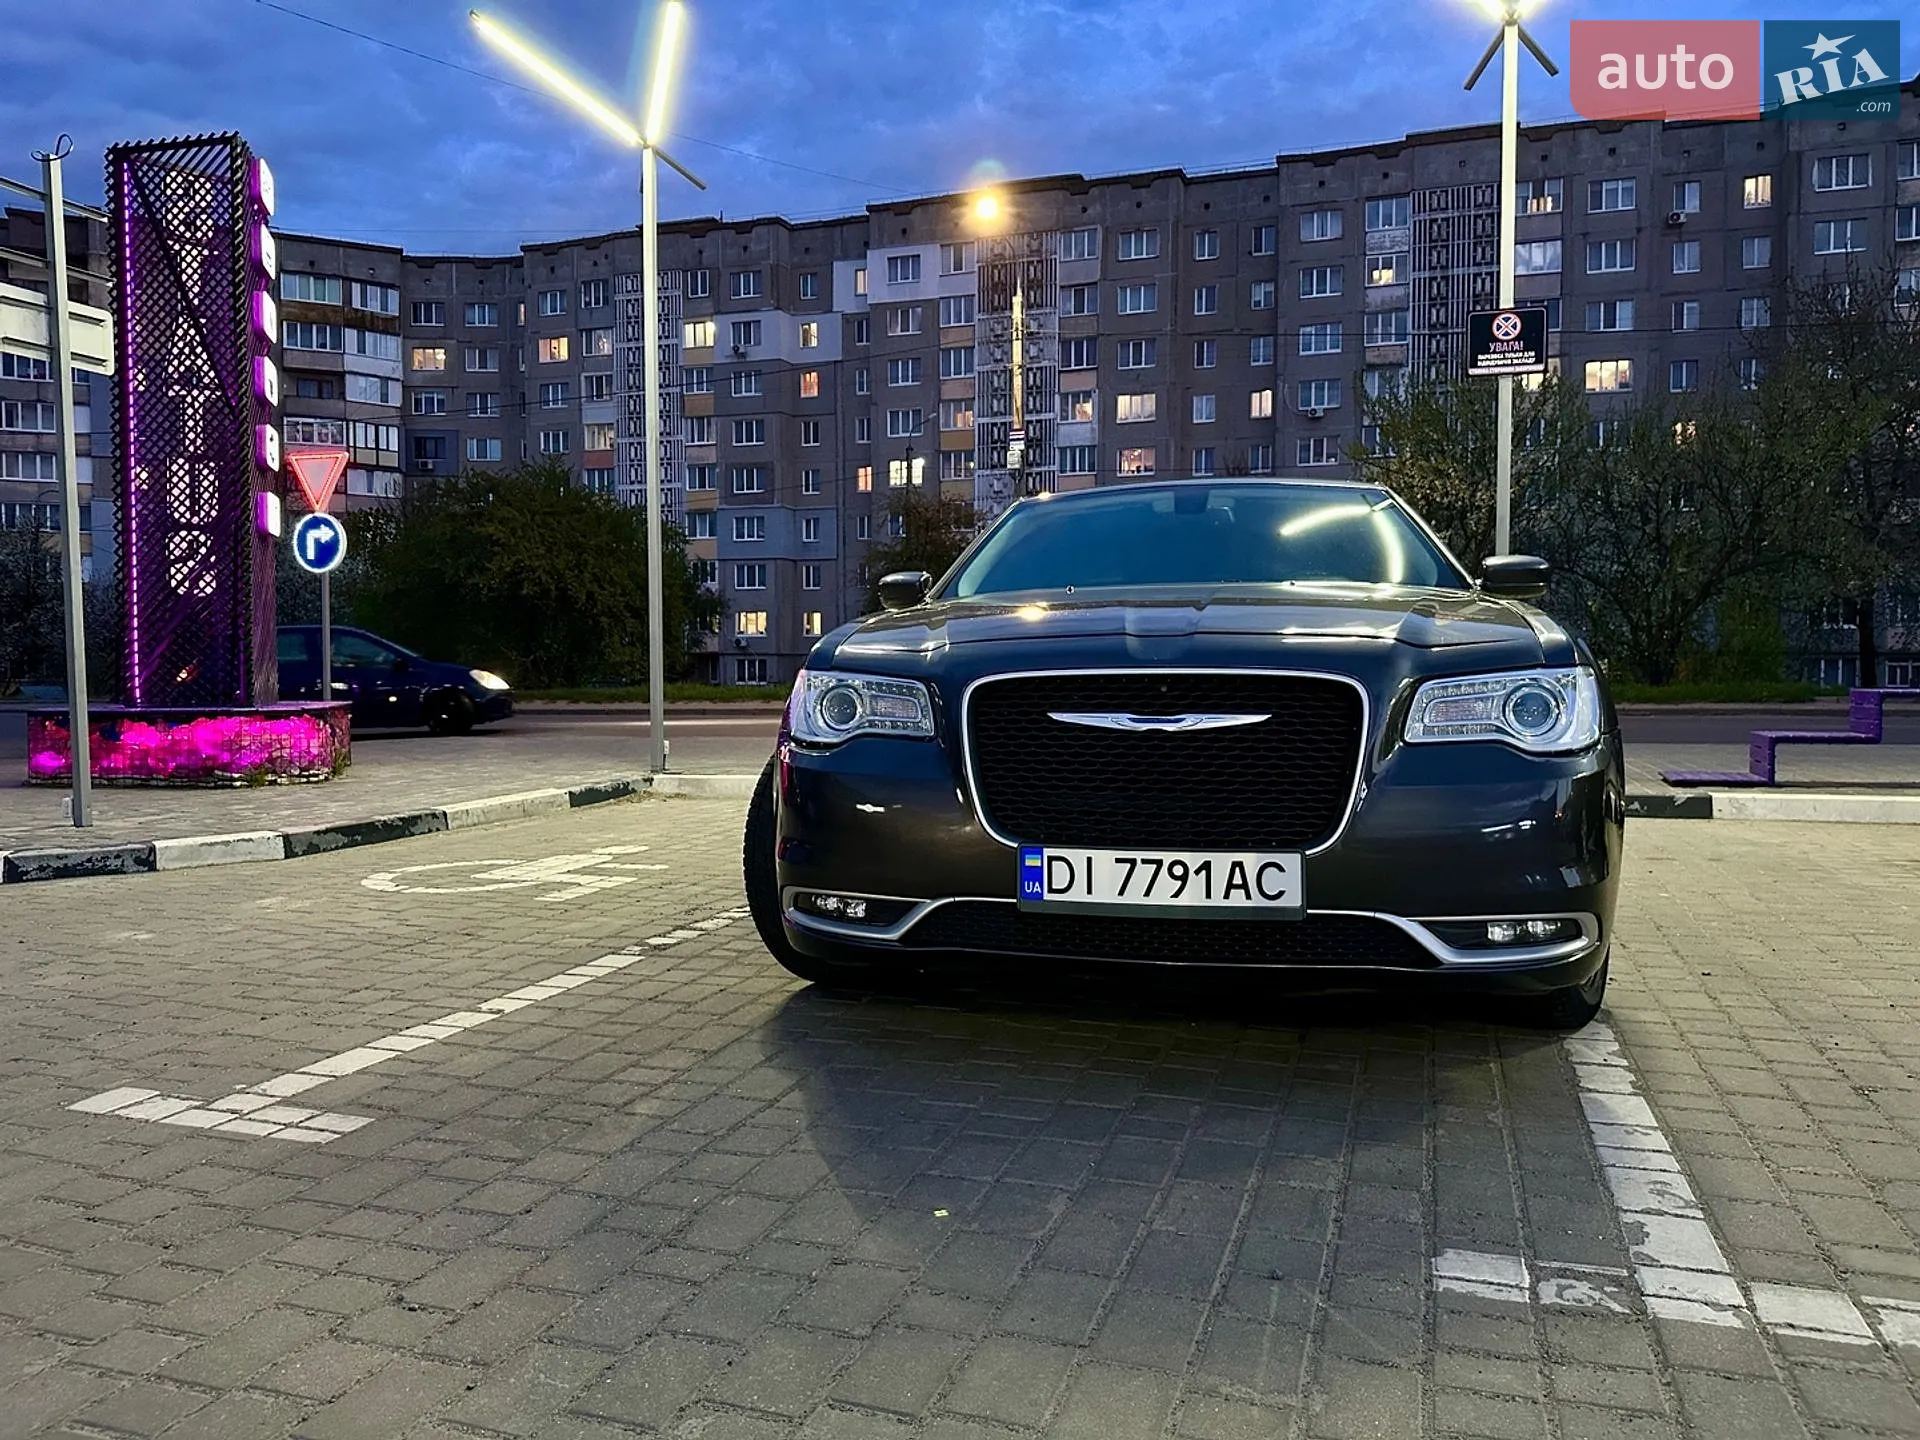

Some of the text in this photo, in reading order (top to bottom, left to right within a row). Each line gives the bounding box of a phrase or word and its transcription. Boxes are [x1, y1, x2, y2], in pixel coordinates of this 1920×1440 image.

[1489, 341, 1523, 352] УВАГА!
[1046, 855, 1093, 895] DI
[1025, 880, 1041, 893] UA
